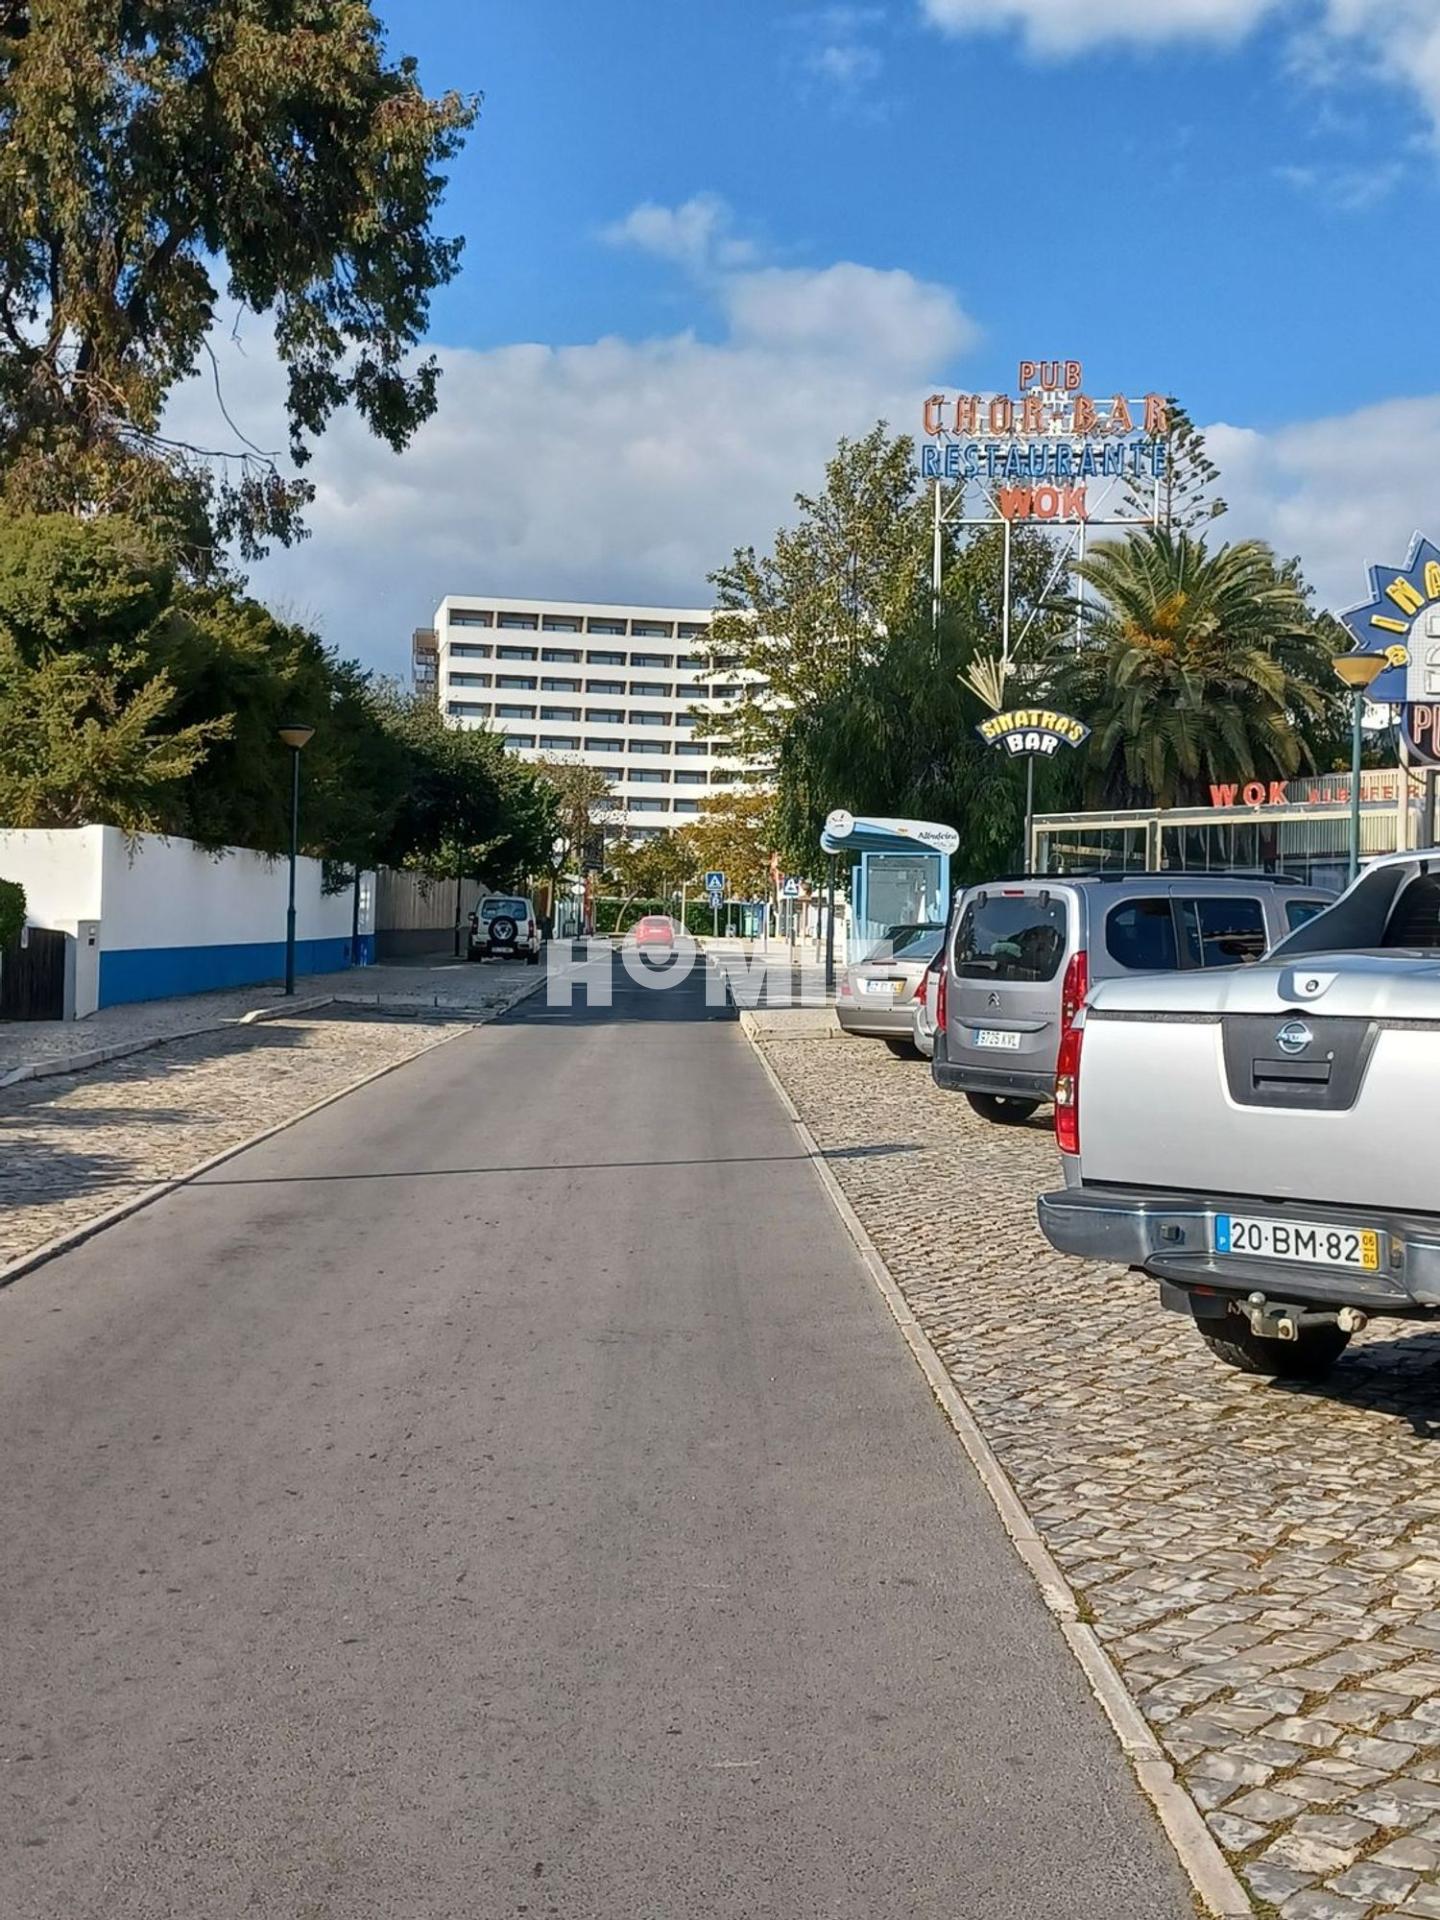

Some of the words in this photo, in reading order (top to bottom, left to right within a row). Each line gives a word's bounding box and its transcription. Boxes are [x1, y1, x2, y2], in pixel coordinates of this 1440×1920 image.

[1019, 360, 1081, 391] PUB
[921, 443, 1168, 478] RESTAURANTE
[998, 486, 1089, 520] WOK
[981, 709, 1083, 740] SINATRA'S
[1006, 732, 1058, 754] BAR
[1209, 780, 1290, 808] WOK
